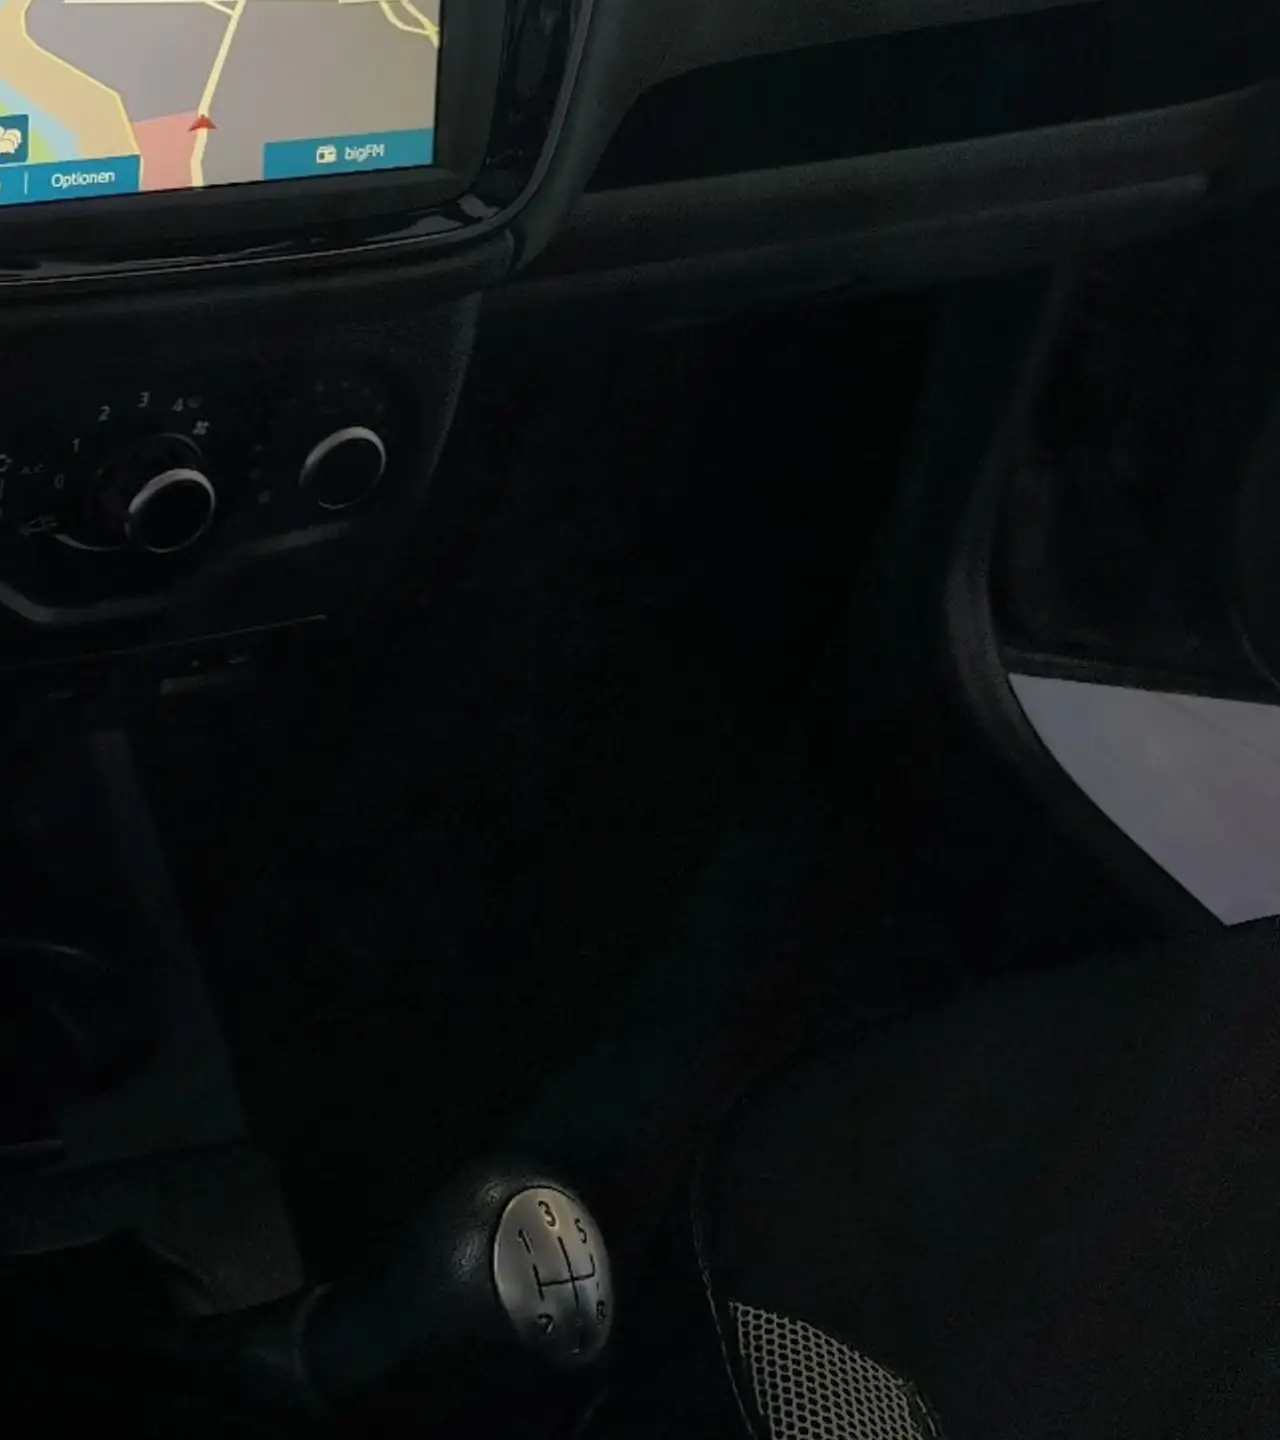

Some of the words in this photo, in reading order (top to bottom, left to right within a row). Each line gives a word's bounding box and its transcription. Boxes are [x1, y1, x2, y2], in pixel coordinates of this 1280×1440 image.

[343, 143, 385, 163] bigFM
[50, 168, 116, 190] Optionen
[136, 391, 151, 409] 3
[171, 396, 185, 413] 4
[97, 405, 112, 422] 2
[537, 1199, 557, 1228] 3
[574, 1217, 588, 1244] 5
[517, 1228, 535, 1256] 1
